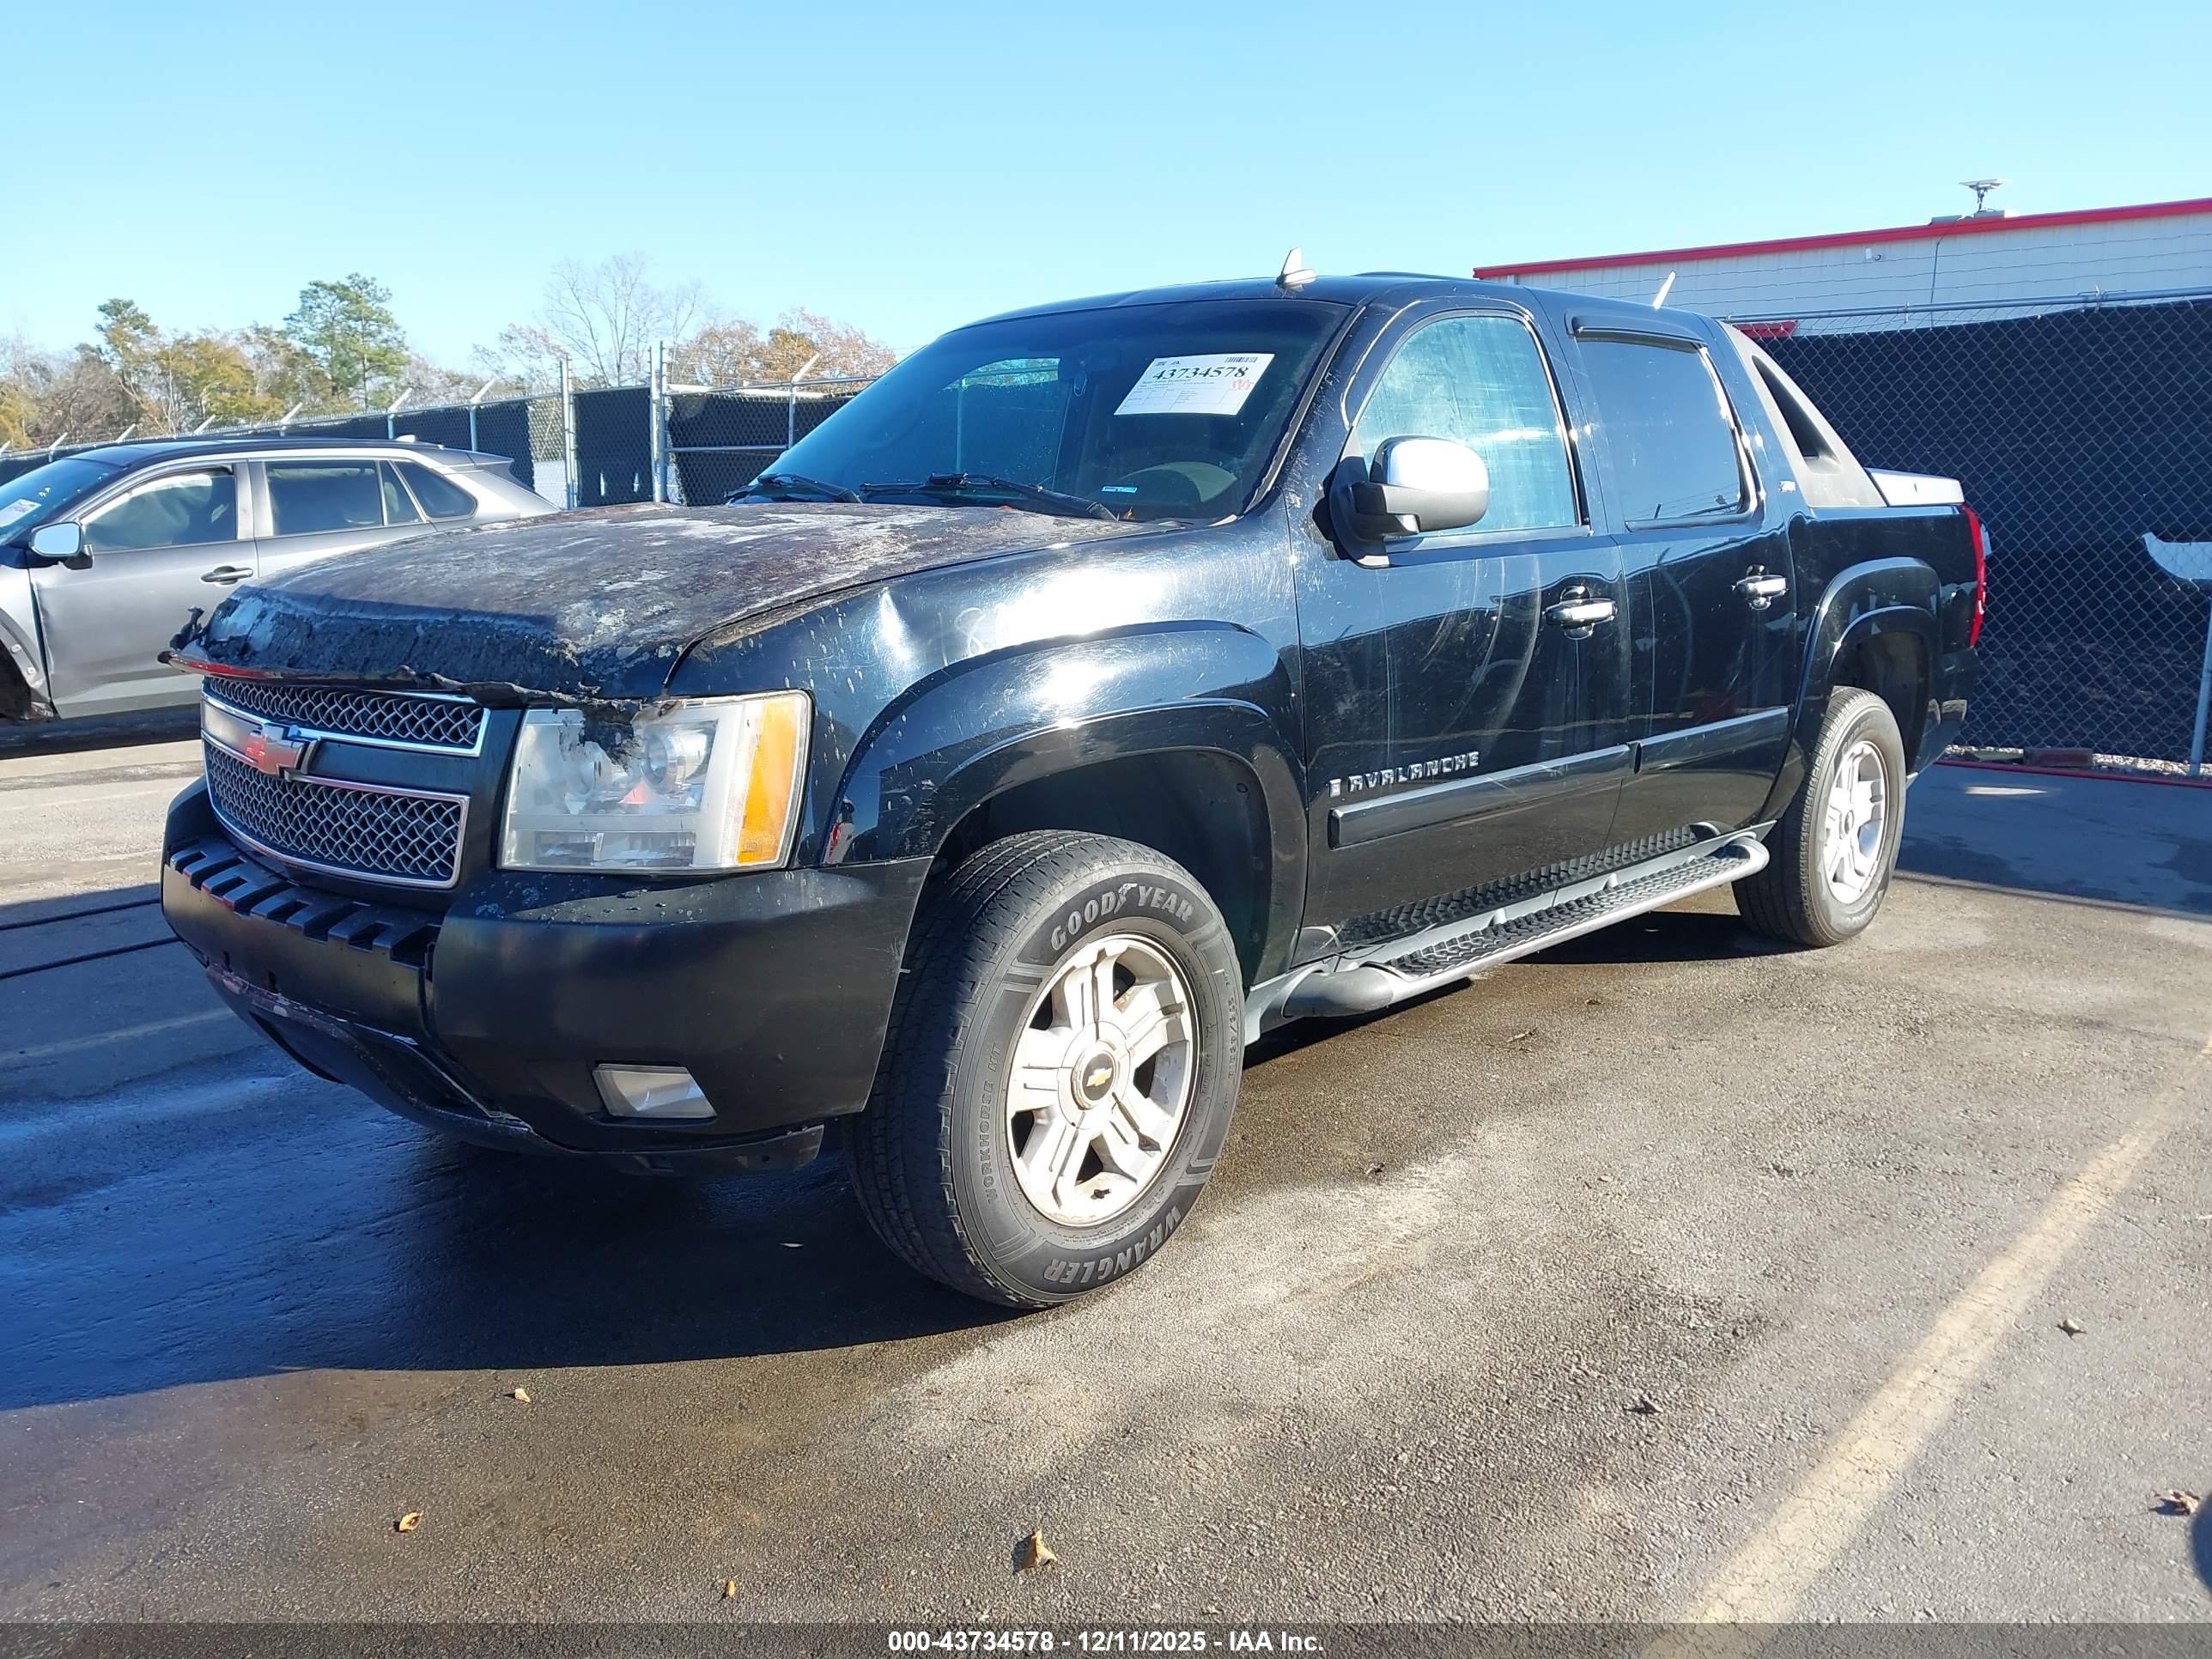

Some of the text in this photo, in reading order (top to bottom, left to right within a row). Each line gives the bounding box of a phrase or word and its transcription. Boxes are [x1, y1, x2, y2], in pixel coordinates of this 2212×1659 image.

[1152, 367, 1249, 380] 43734578
[1348, 750, 1480, 793] AVALANCHE
[979, 1080, 999, 1204] WORKHORSE
[1043, 1205, 1182, 1284] WRANGLER
